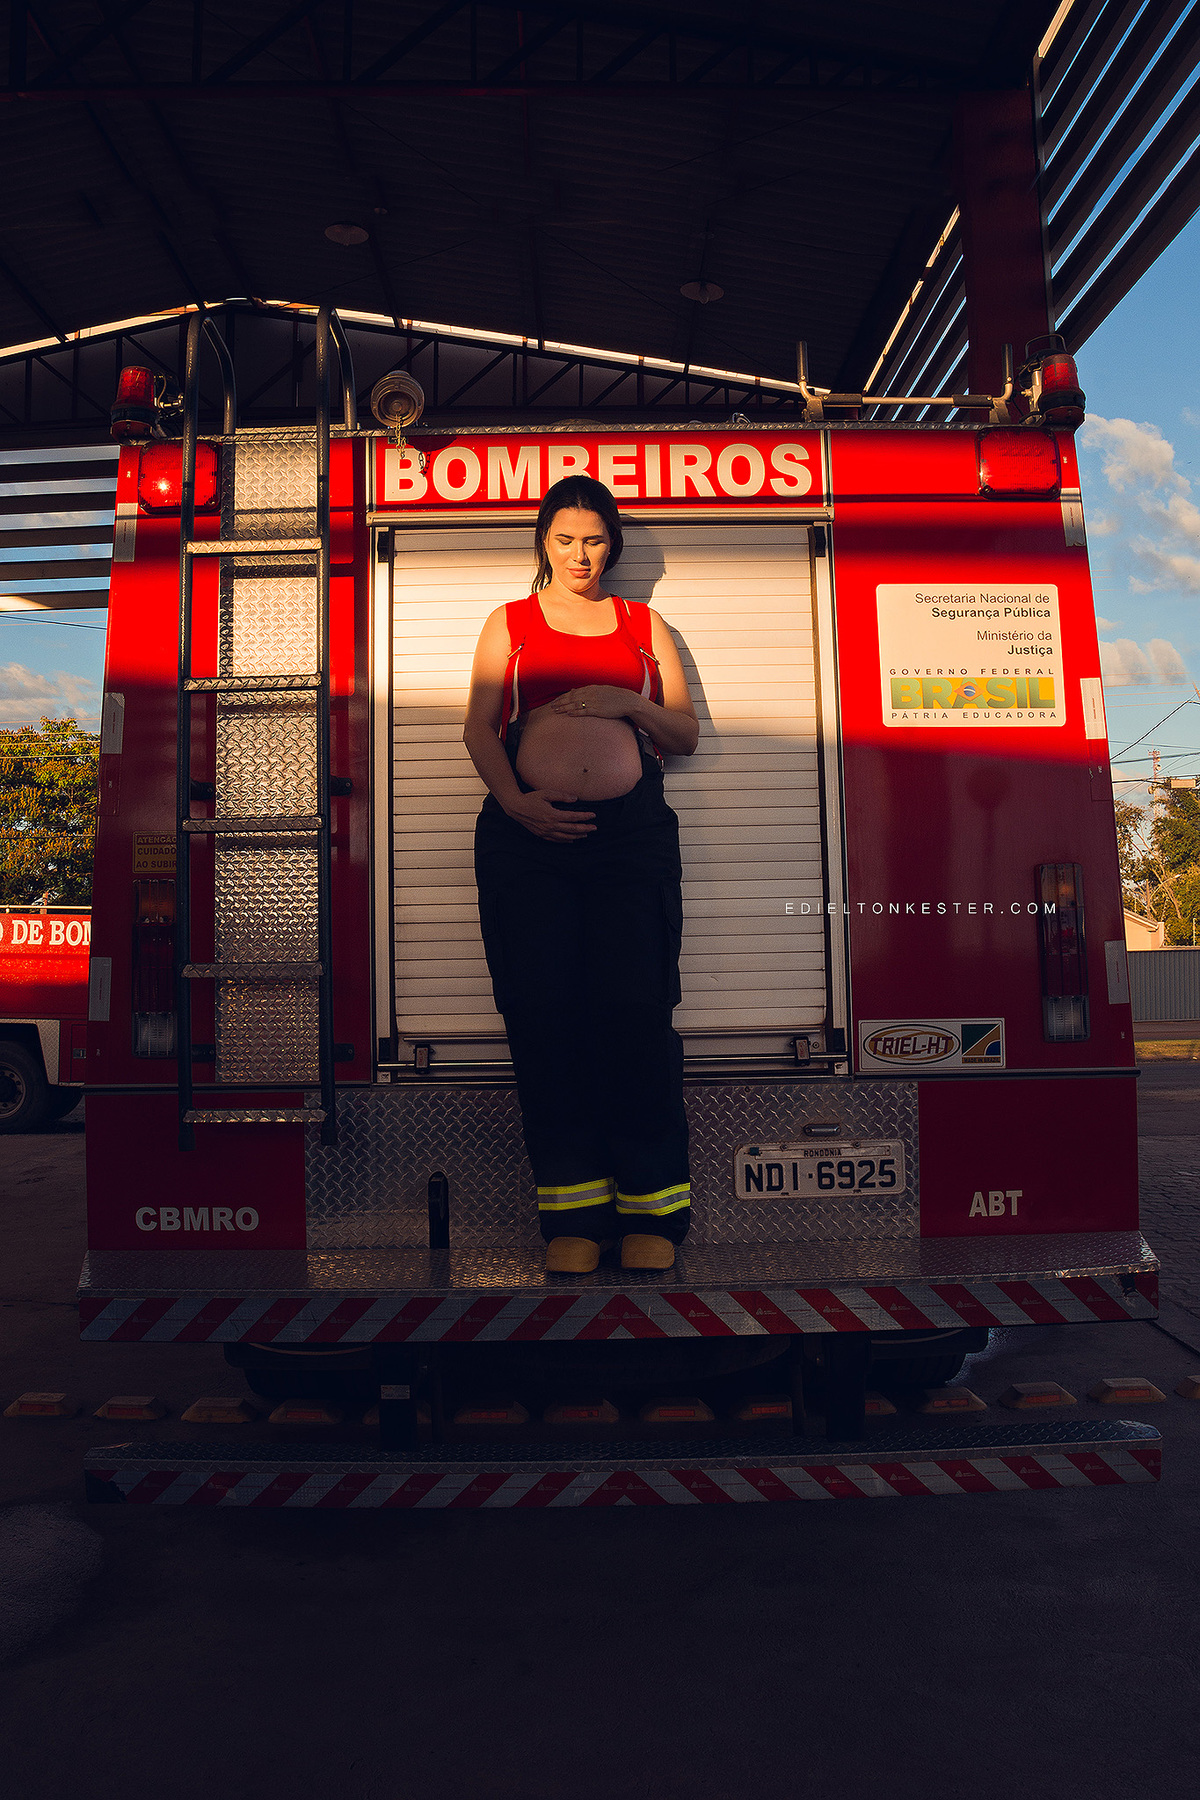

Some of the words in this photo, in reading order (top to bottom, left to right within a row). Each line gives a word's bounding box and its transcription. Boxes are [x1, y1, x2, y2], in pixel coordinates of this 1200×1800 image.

[384, 443, 812, 501] BOMBEIROS
[915, 593, 976, 604] Secretaria
[980, 593, 1031, 603] Nacional
[1034, 593, 1050, 603] de
[931, 607, 1000, 620] Segurança
[1004, 606, 1051, 618] Pública
[976, 630, 1034, 641] Ministério
[1037, 630, 1052, 641] da
[1007, 645, 1053, 657] Justiça
[890, 677, 1056, 709] BRASIL
[891, 711, 949, 719] PÁTRIA
[962, 711, 1057, 719] EDUCADORA
[137, 847, 177, 855] CUIDADO
[11, 920, 43, 945] DE
[870, 1036, 953, 1055] TRIEL-HT
[968, 1189, 1023, 1218] ABT
[135, 1206, 260, 1231] CBMRO
